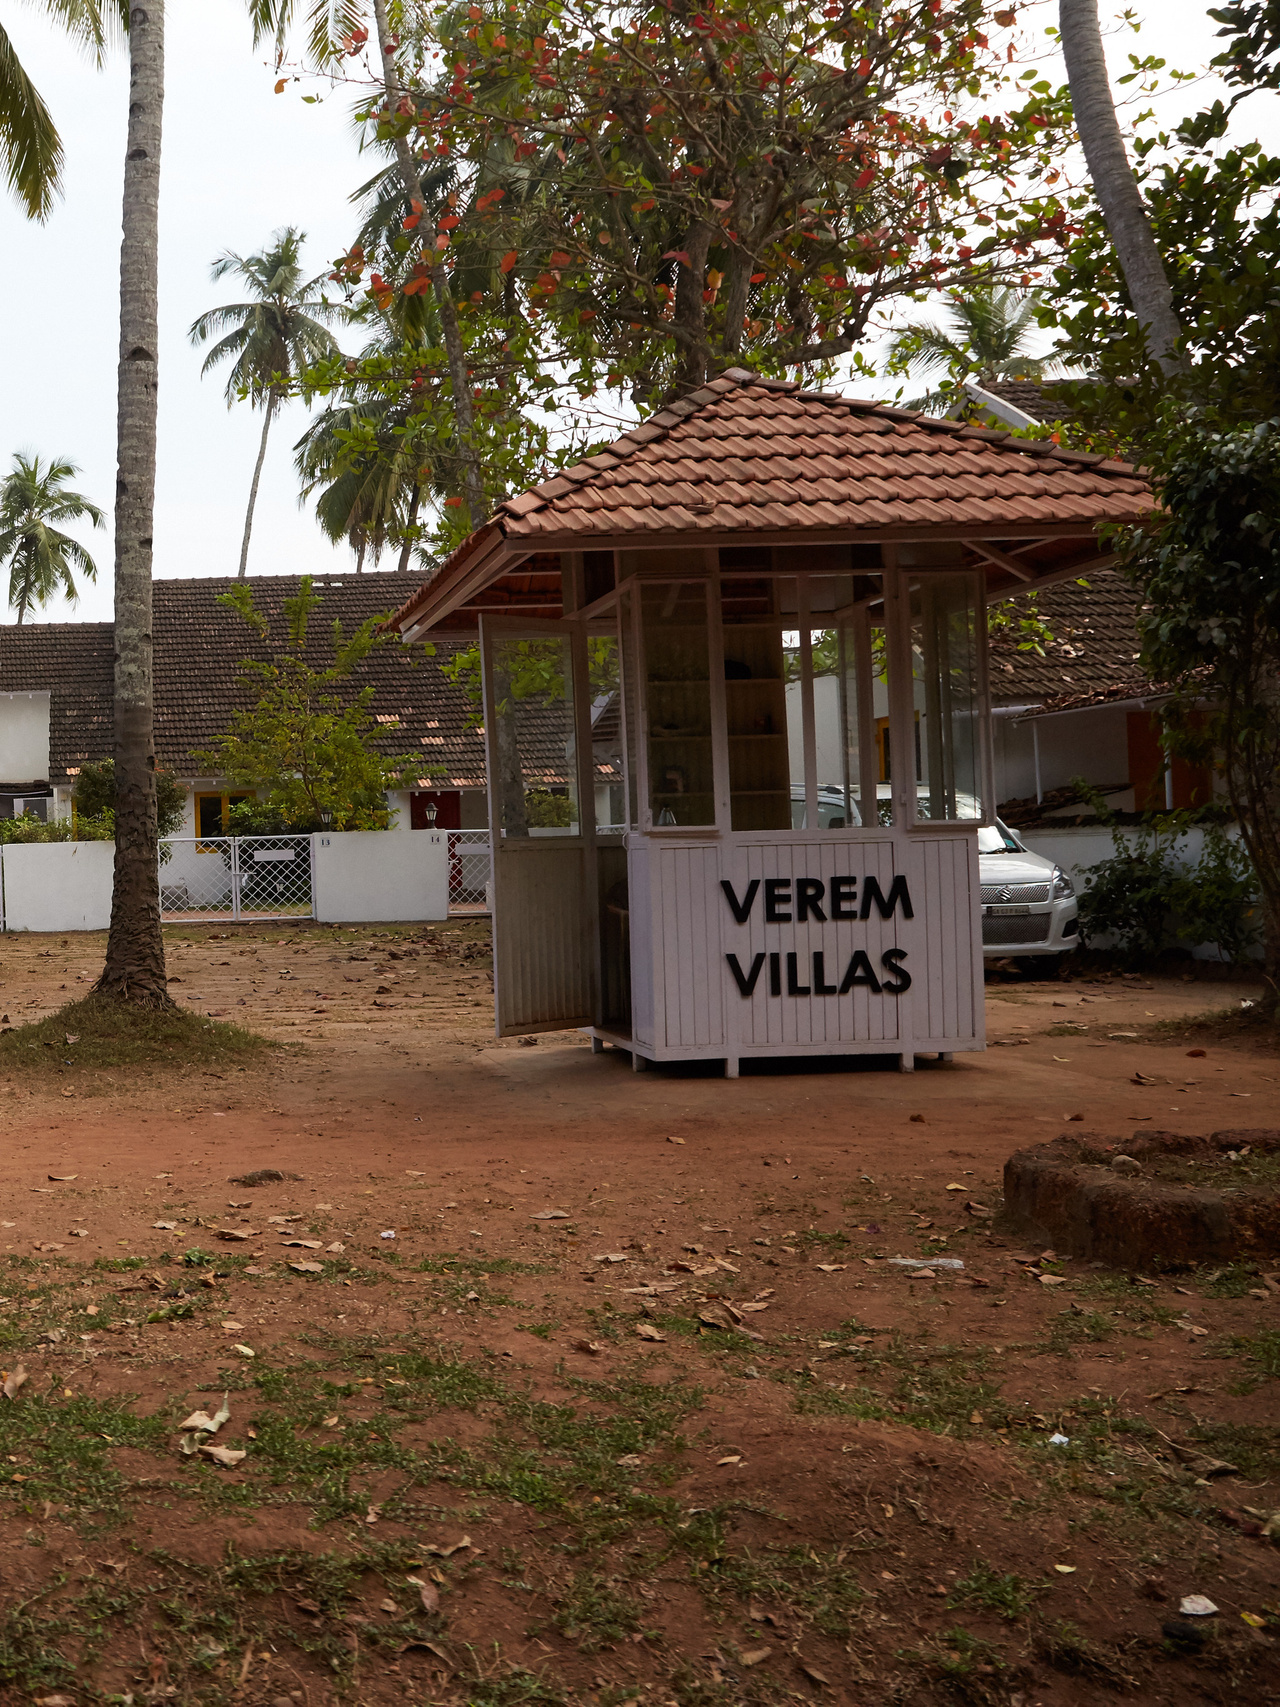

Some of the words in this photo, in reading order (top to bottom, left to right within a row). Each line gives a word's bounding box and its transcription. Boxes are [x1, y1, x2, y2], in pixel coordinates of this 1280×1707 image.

[321, 838, 331, 846] 13
[431, 835, 440, 843] 14
[720, 875, 914, 922] VEREM
[726, 948, 912, 996] VILLAS
